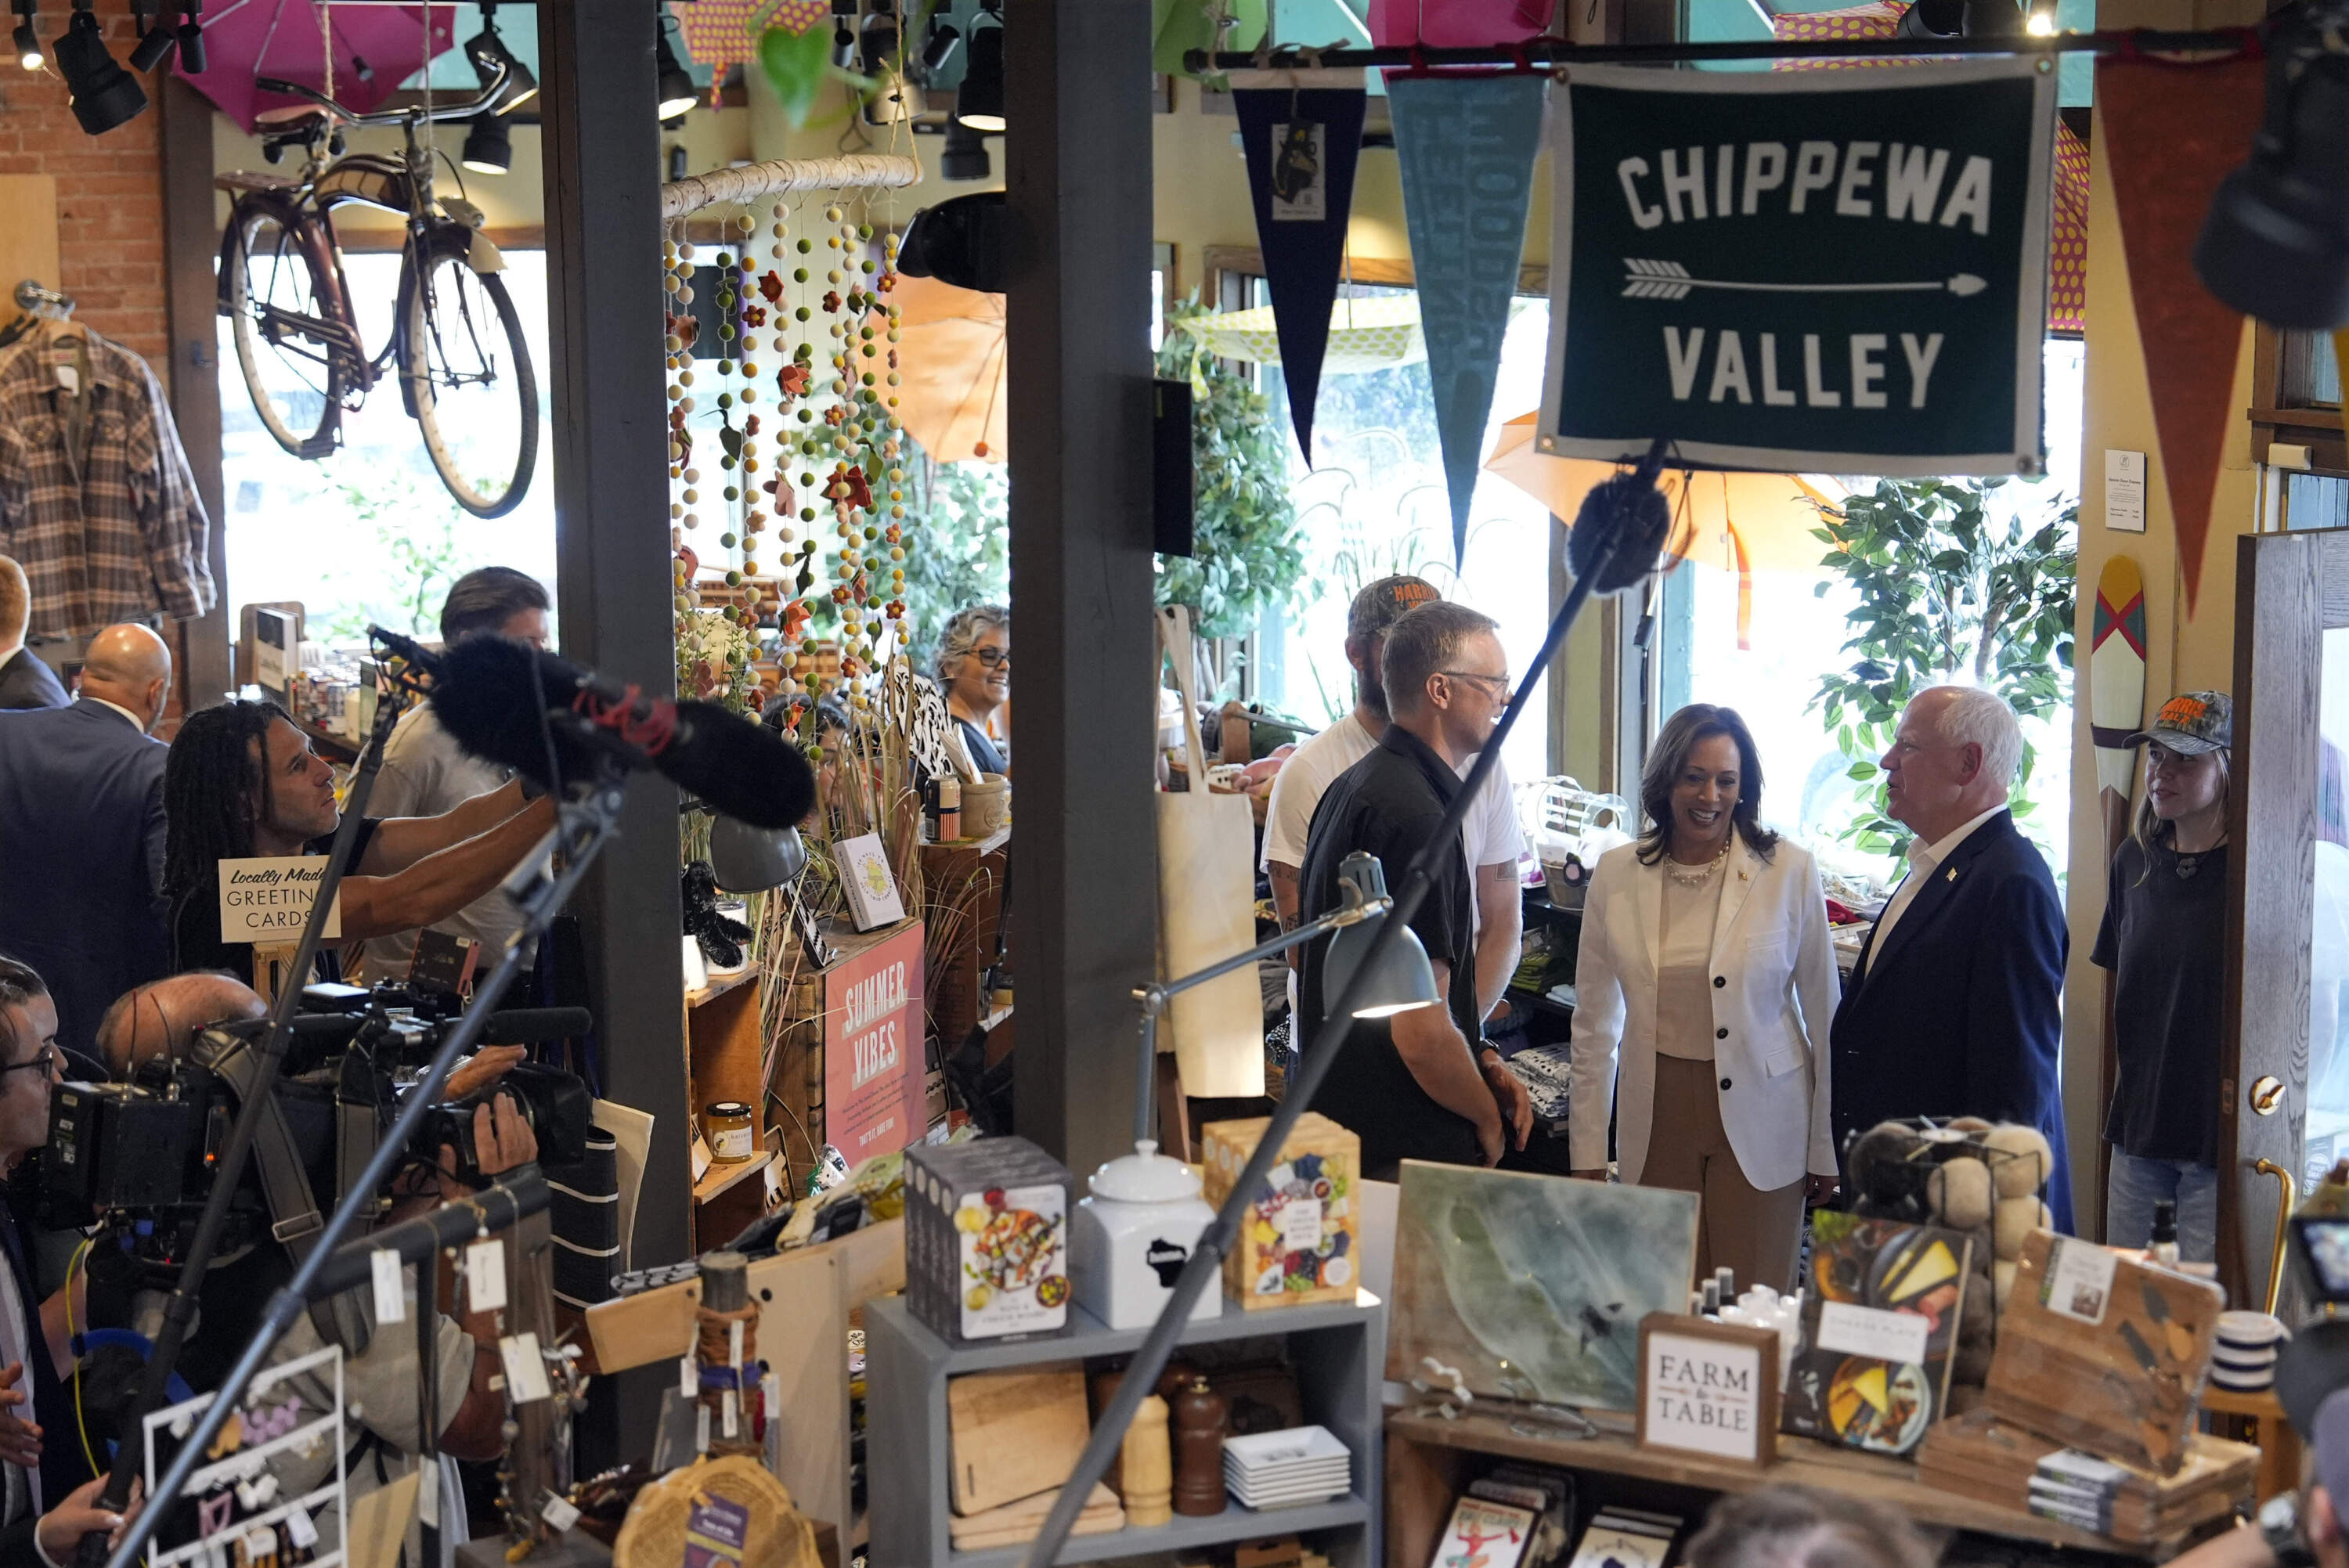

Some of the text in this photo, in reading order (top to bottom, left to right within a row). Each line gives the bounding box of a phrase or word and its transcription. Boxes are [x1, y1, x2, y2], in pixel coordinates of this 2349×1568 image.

[1618, 142, 1991, 234] CHIPPEWA
[1664, 326, 1943, 408] VALLEY
[227, 889, 315, 906] GREETIN
[230, 869, 283, 885] Locally
[845, 961, 905, 1033] SUMMER
[854, 1020, 897, 1084] VIBES
[1658, 1354, 1748, 1392] FARM
[1657, 1396, 1748, 1432] TABLE
